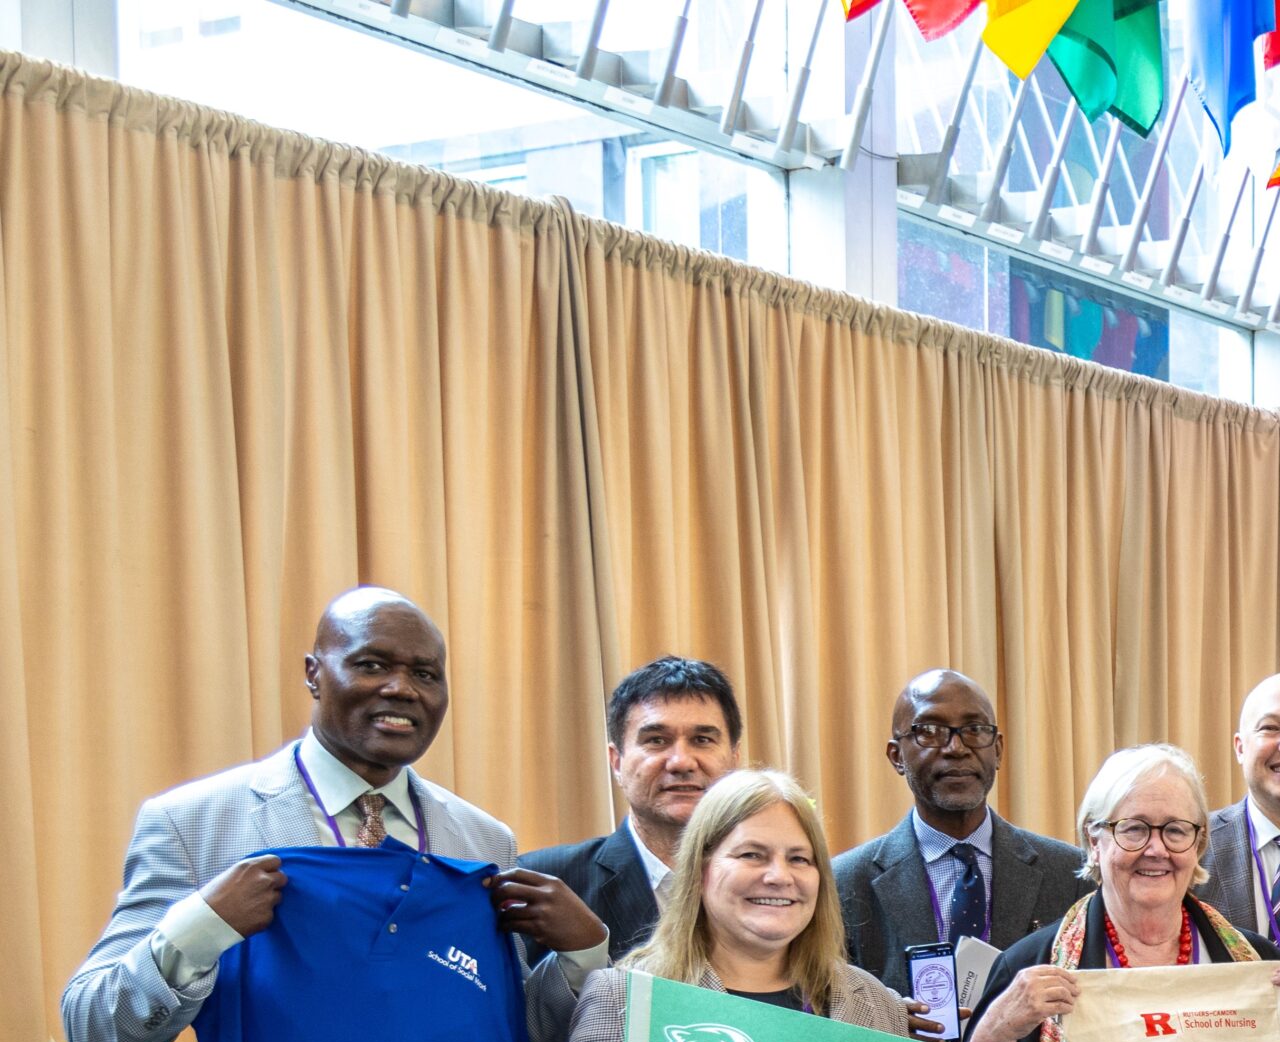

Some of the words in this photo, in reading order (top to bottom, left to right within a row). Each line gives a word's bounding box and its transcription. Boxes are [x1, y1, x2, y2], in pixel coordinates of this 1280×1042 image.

[428, 950, 450, 967] School
[457, 966, 475, 981] Social
[473, 976, 487, 992] Work
[447, 945, 478, 975] UTA
[1140, 1012, 1177, 1038] R
[1184, 1018, 1213, 1029] School
[1214, 1018, 1224, 1028] of
[1225, 1017, 1257, 1029] Nursing
